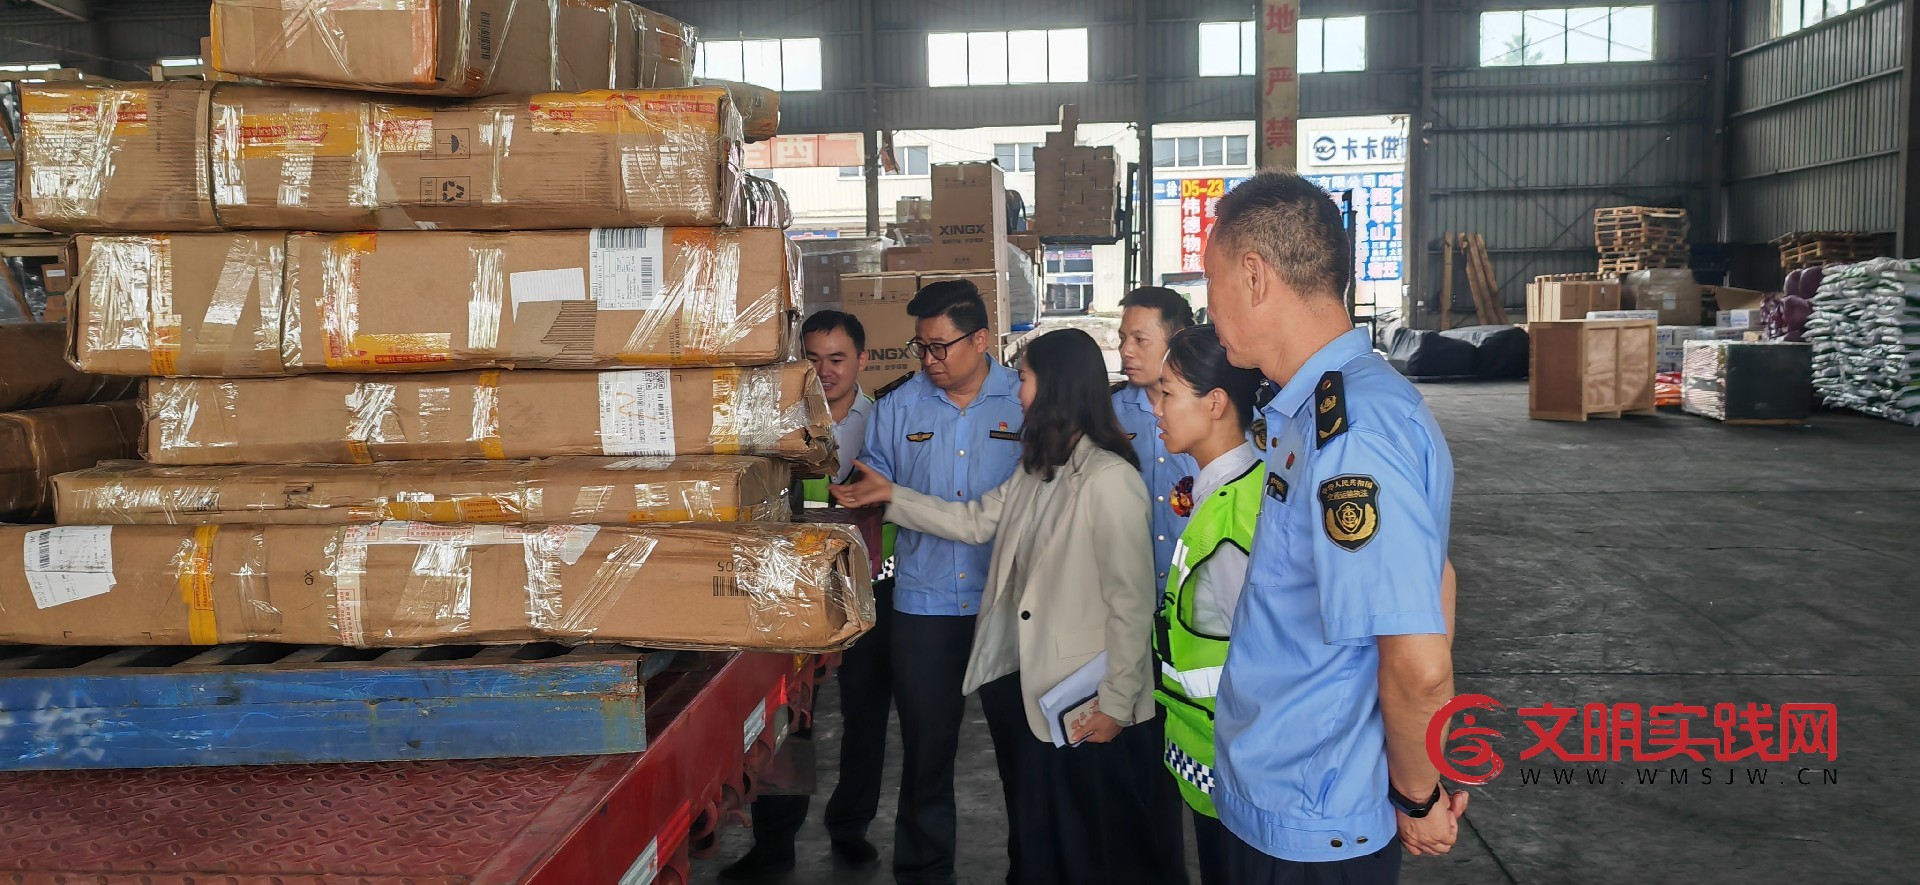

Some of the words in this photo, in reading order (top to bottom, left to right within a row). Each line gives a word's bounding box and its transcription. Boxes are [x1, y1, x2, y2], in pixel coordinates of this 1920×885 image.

[1265, 3, 1295, 149] 地严禁
[1181, 179, 1225, 197] D5-23
[1309, 174, 1377, 189] 有限公司
[939, 224, 986, 236] XINGX
[867, 347, 911, 361] INGX
[304, 569, 315, 586] QX
